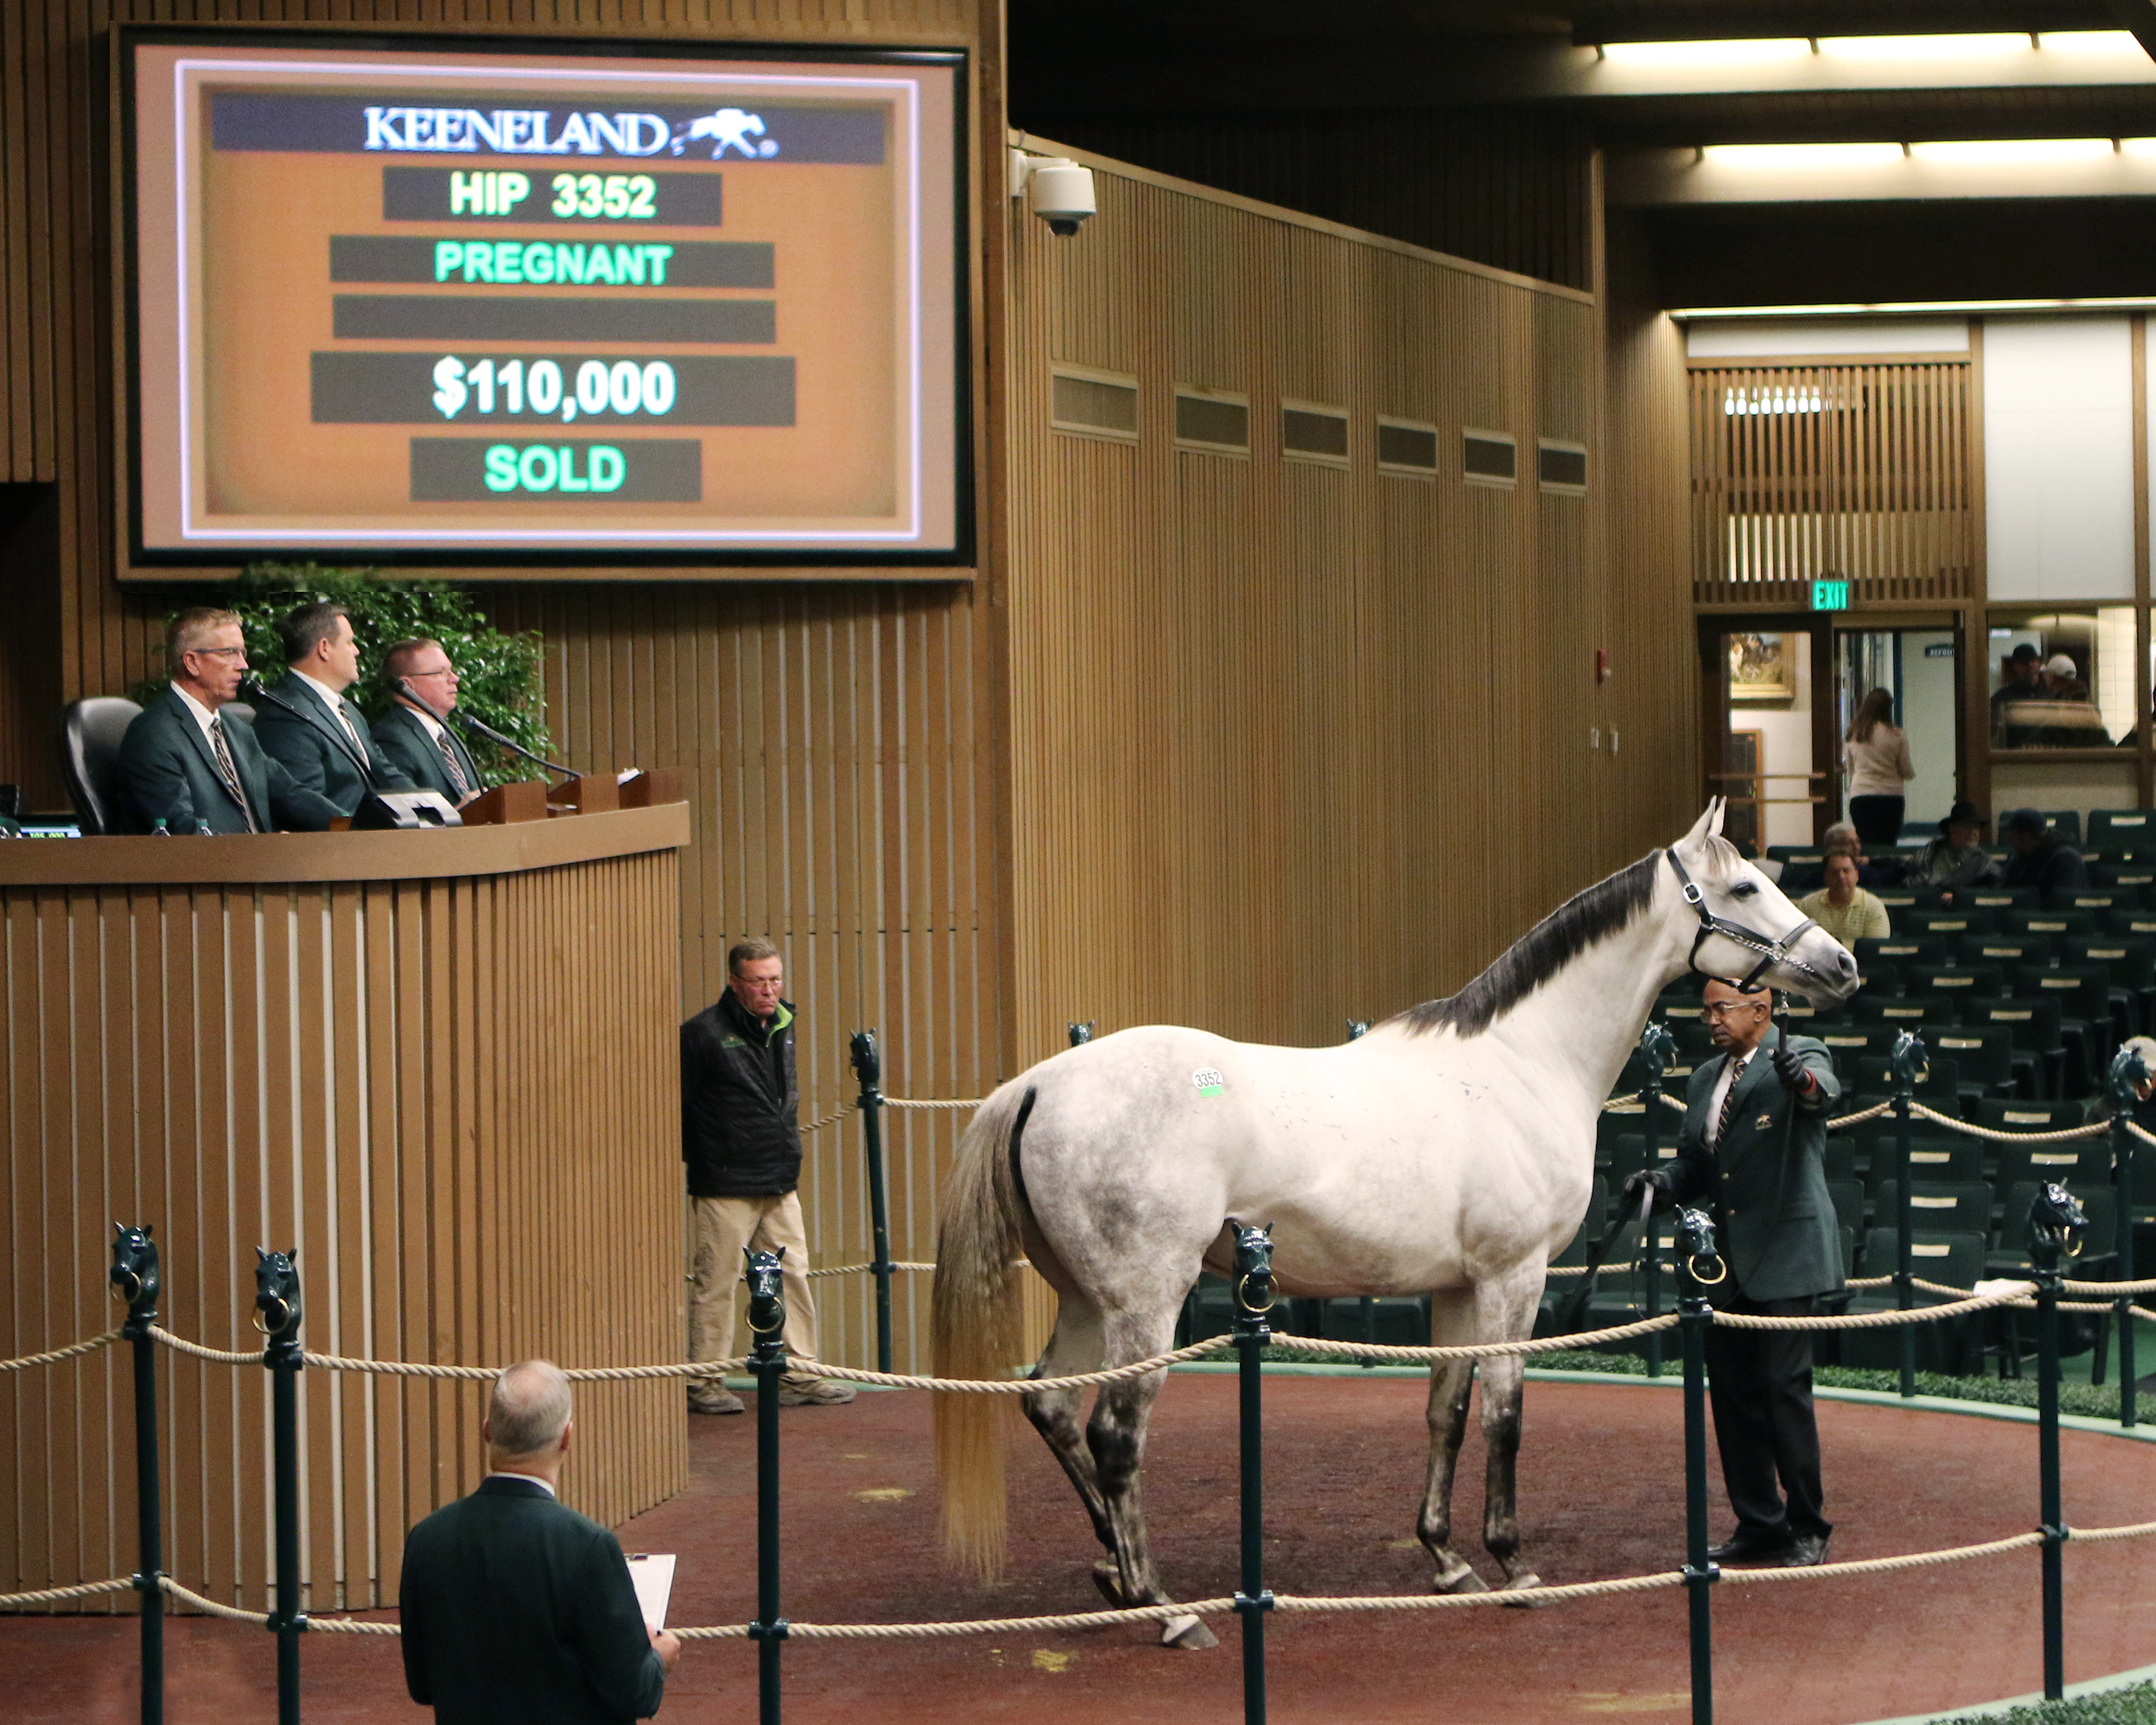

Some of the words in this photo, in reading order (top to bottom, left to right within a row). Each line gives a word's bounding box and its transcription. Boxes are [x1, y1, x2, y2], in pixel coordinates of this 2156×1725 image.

[364, 106, 670, 157] KEENELAND
[450, 171, 531, 216] HIP
[551, 173, 657, 219] 3352
[434, 241, 672, 285] PREGNANT
[432, 355, 676, 423] $110,000
[483, 444, 627, 493] SOLD
[1813, 581, 1848, 610] EXIT
[1195, 1072, 1222, 1087] 3352
